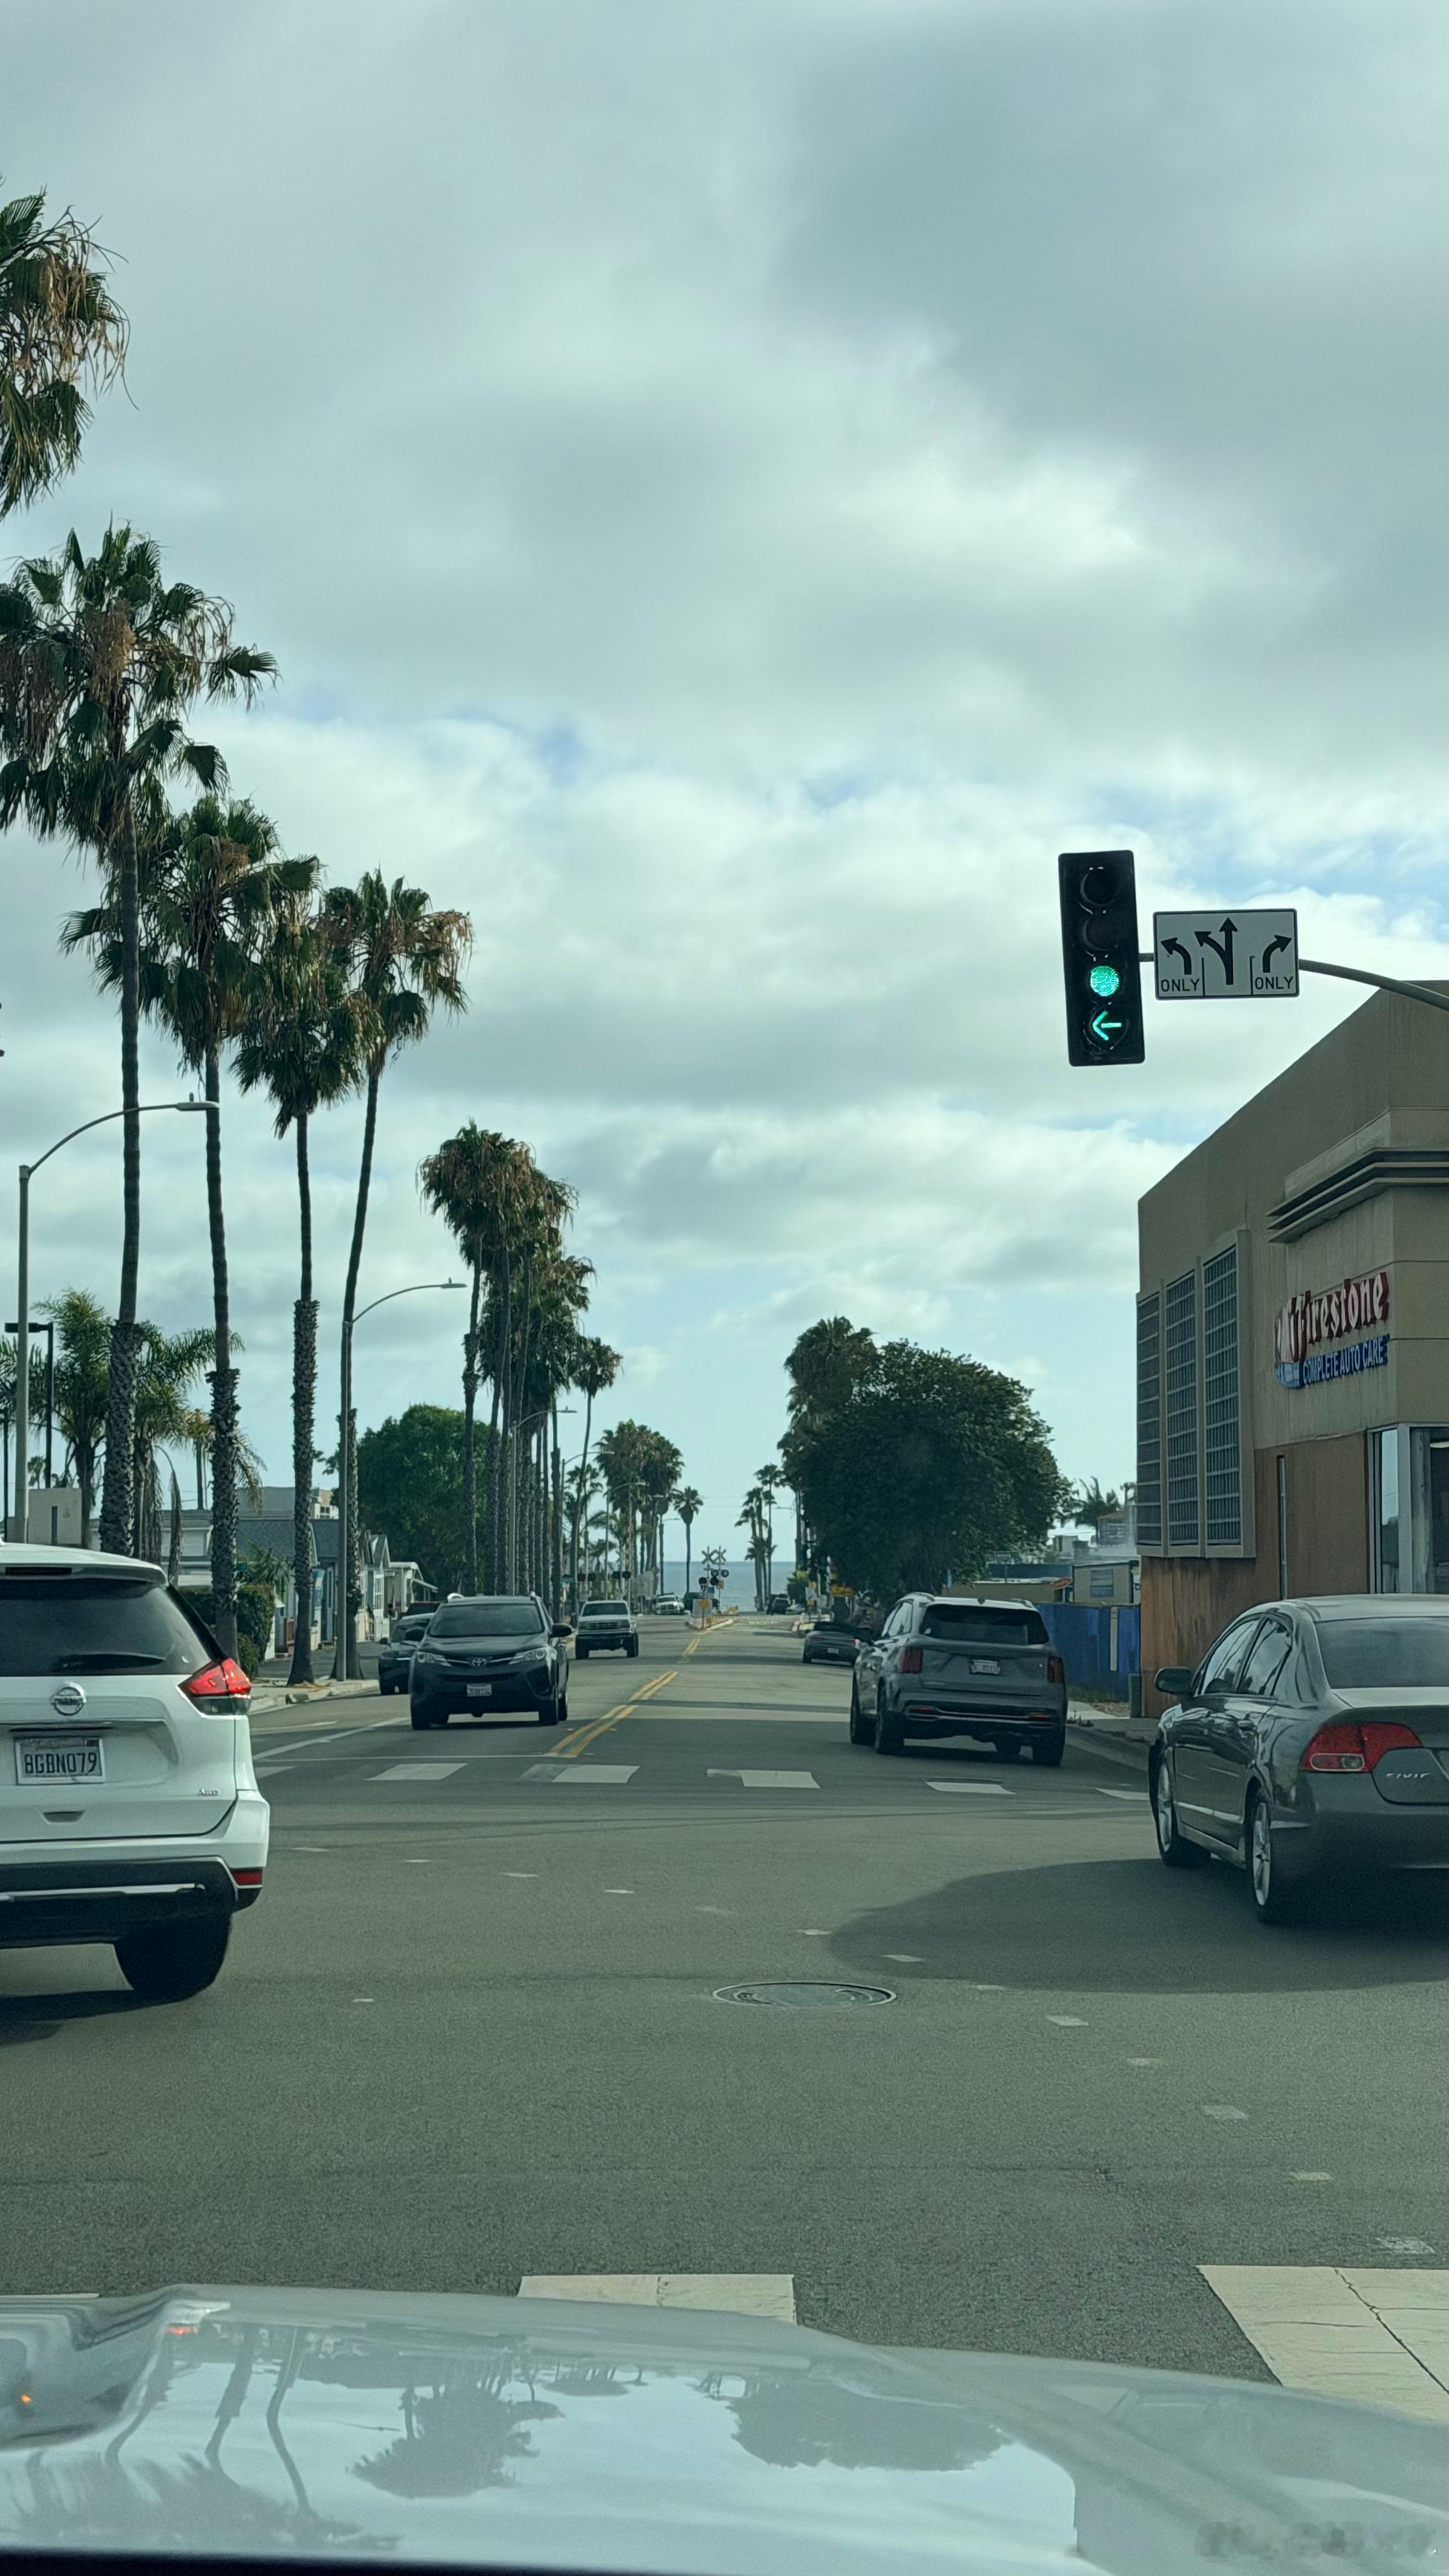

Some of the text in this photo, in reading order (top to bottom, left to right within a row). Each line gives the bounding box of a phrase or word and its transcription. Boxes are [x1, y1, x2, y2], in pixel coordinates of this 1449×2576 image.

[1161, 979, 1200, 992] ONLY
[1255, 976, 1293, 990] ONLY
[1292, 1273, 1388, 1361] Firestone
[1303, 1338, 1384, 1384] COMPLETE AUTO CARE
[24, 1752, 96, 1774] 8GBN079
